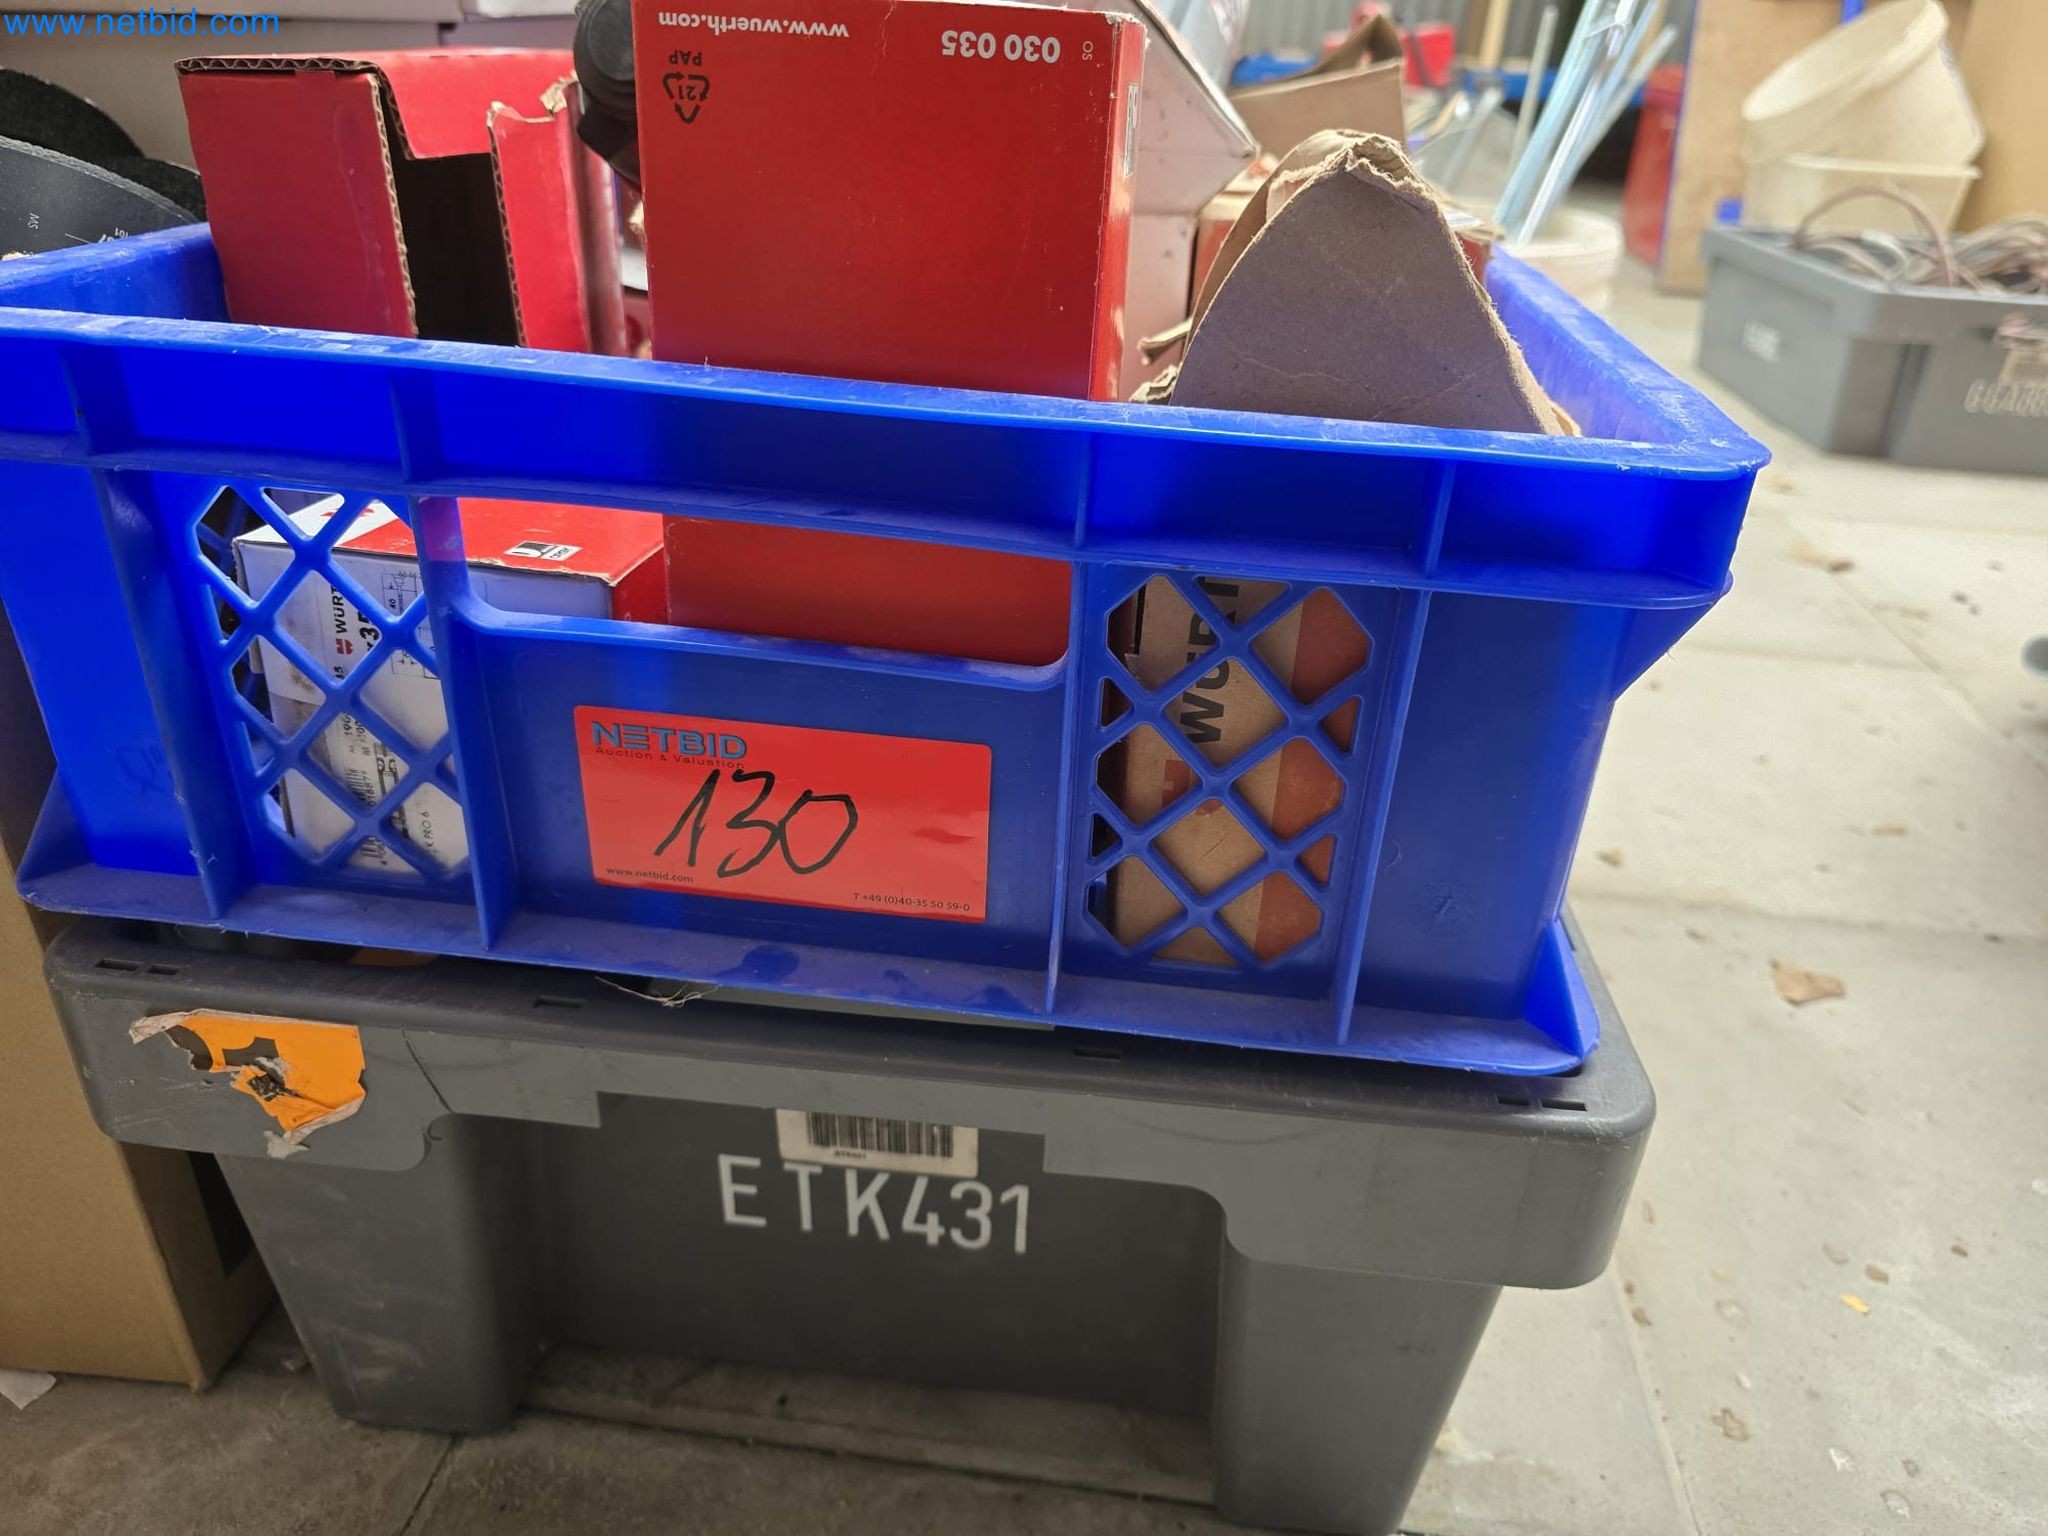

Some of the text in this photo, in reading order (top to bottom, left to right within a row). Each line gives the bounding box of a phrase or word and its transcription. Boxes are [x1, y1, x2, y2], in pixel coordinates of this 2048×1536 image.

[658, 12, 850, 38] www.wuerth.com
[940, 29, 1061, 64] 030 035
[668, 50, 703, 67] PAP
[677, 84, 697, 101] 21
[592, 721, 748, 760] NETBID
[596, 746, 745, 769] Auction & Valuation
[654, 769, 859, 879] 130
[606, 867, 695, 883] www.netbid.com
[884, 895, 928, 907] (0)40-35
[930, 900, 944, 909] 50
[946, 902, 971, 912] 59-0
